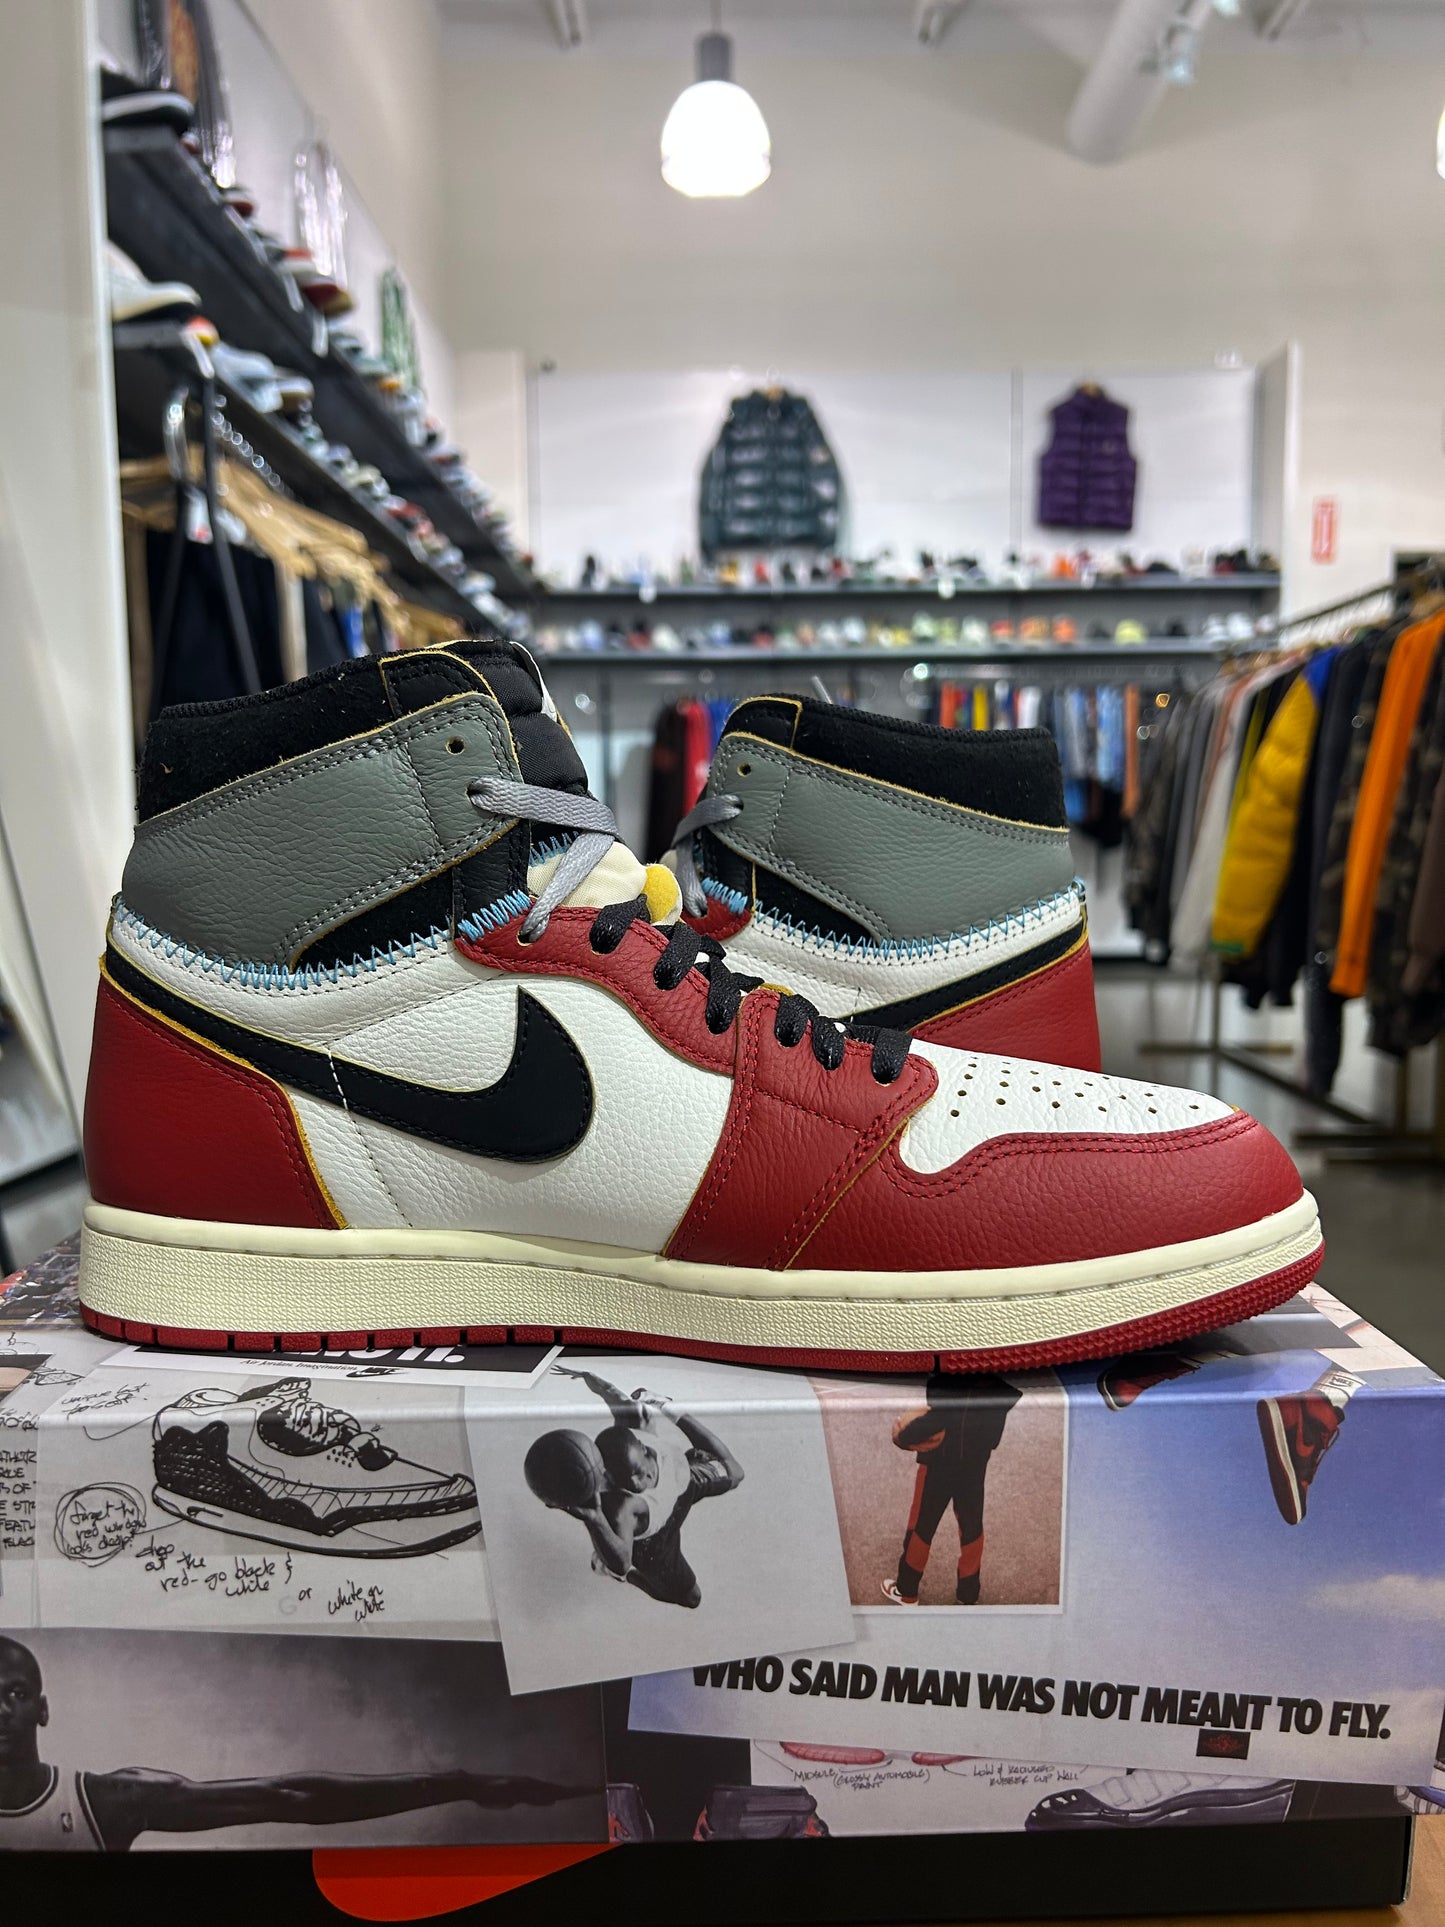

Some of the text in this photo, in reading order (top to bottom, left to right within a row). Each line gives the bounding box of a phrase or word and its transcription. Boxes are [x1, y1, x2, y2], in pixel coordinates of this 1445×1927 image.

[204, 1571, 227, 1591] go
[235, 1556, 276, 1580] black
[225, 1577, 270, 1597] white
[298, 1587, 313, 1601] or
[328, 1579, 363, 1615] white
[693, 1656, 1391, 1740] WHO SAID MAN WAS NOT MEANT TO FLY.
